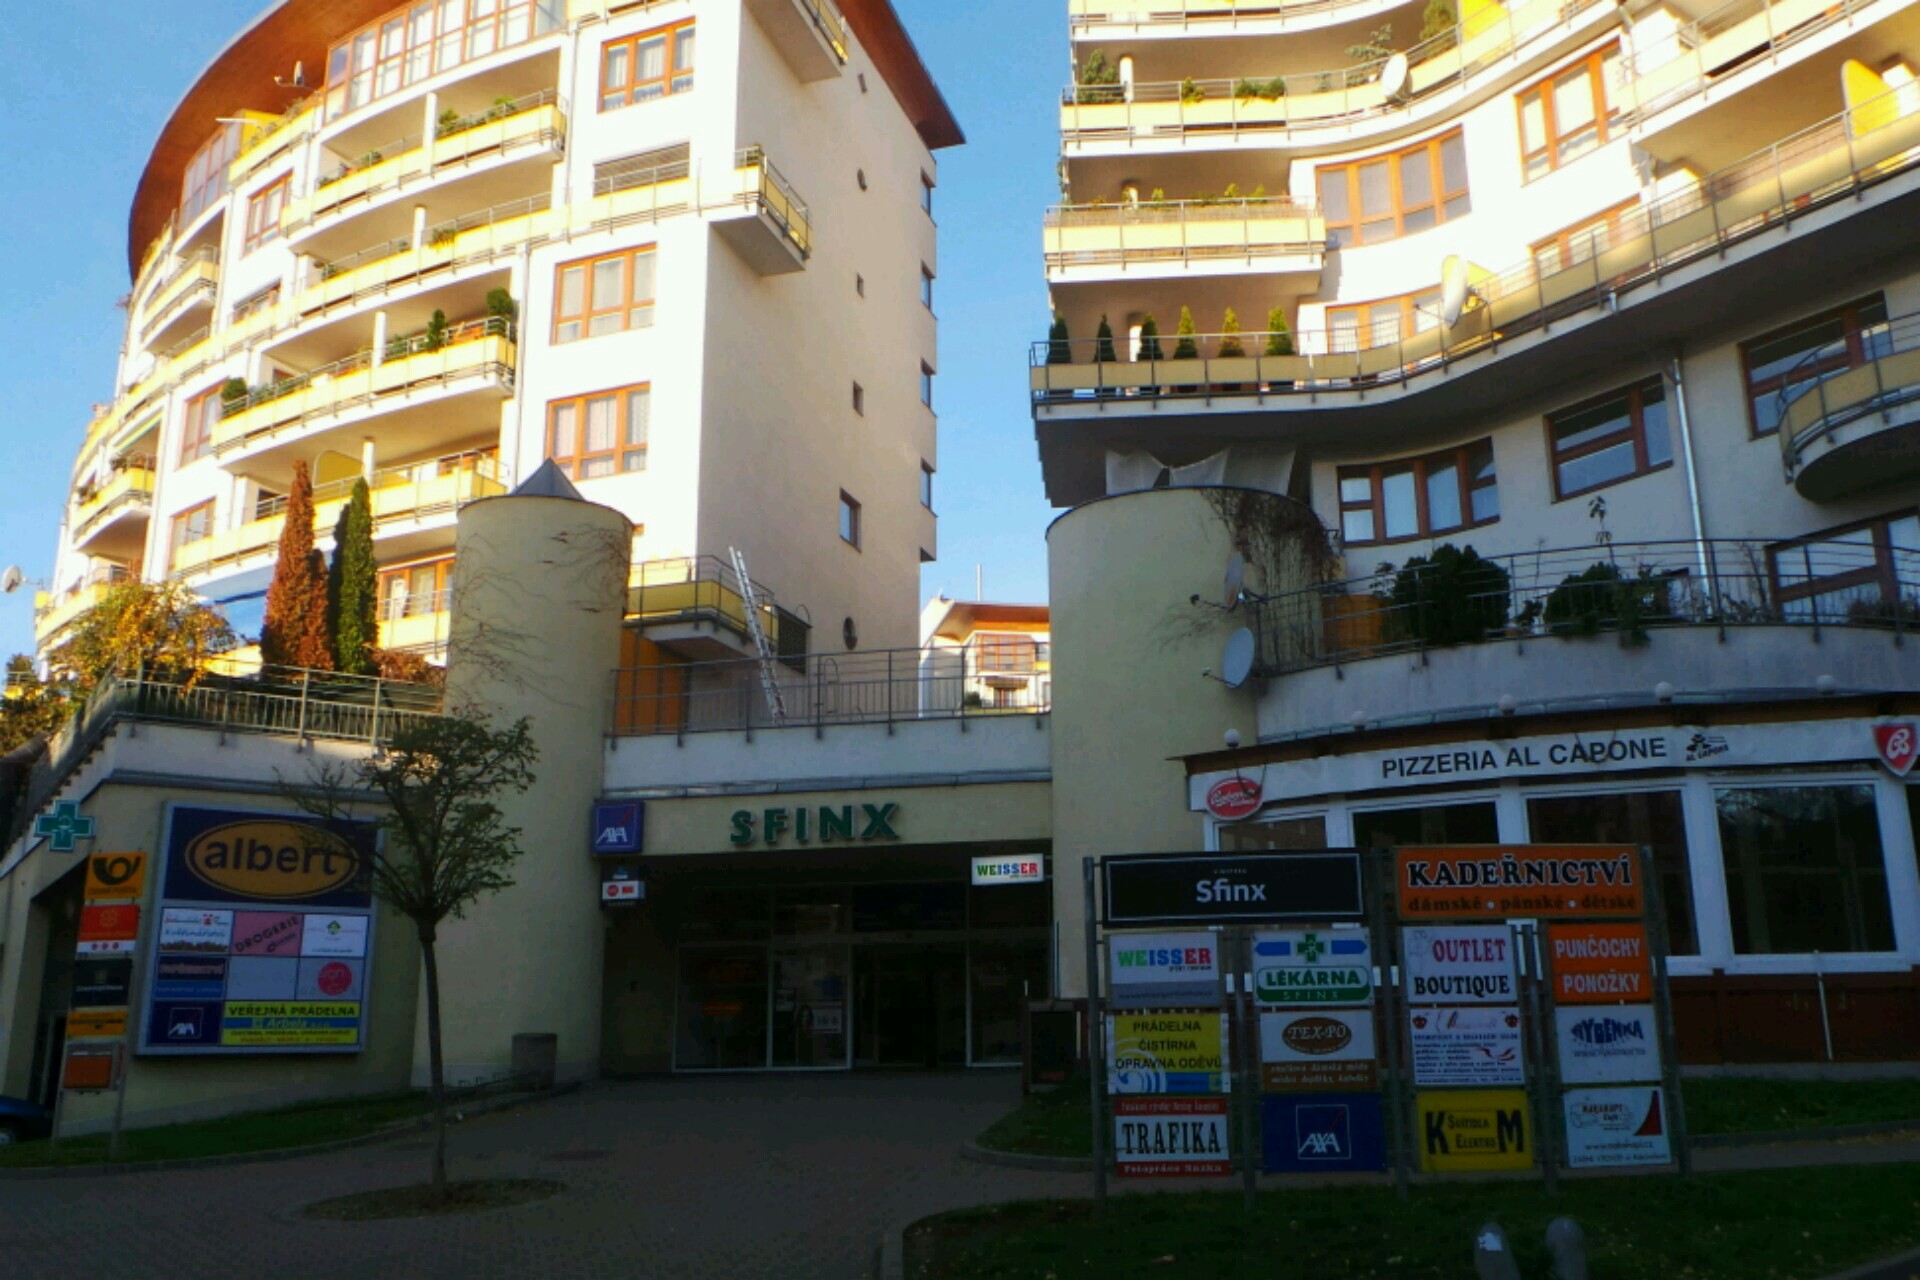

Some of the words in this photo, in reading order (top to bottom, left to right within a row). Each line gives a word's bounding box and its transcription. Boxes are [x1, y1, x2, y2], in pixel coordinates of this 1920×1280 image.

[1382, 750, 1498, 779] PIZZERIA
[1506, 747, 1540, 767] AL
[1549, 736, 1667, 765] CAPONE
[596, 827, 628, 845] AXA
[731, 804, 898, 845] SFINX
[204, 837, 337, 875] albert
[976, 862, 1038, 877] WEISSER
[1406, 854, 1633, 888] KADEŘNICTVÍ
[1196, 877, 1266, 903] Sfinx
[1407, 898, 1482, 912] dámské
[1500, 896, 1565, 912] pánské
[1581, 894, 1637, 910] dětské
[235, 915, 298, 953] DROGERIE
[1117, 947, 1213, 968] WEISSER
[1432, 938, 1507, 963] OUTLET
[1554, 935, 1641, 959] PUNČOCHY
[1265, 968, 1362, 988] LÉKÁRNA
[1413, 975, 1511, 998] BOUTIQUE
[1563, 969, 1642, 994] PONOŽKY
[1282, 990, 1340, 1001] SFINX
[228, 1003, 286, 1016] VEŘEJNÁ
[290, 1004, 356, 1016] PRÁDELNA
[1132, 1020, 1203, 1033] PRÁDELNA
[1289, 1025, 1347, 1040] TEX-PO
[1571, 1017, 1645, 1044] RYBENKA
[1138, 1038, 1197, 1052] ČISTÍRNA
[1115, 1057, 1176, 1070] OPRAVNA
[1179, 1054, 1222, 1070] ODĚVŮ
[1121, 1121, 1222, 1155] TRAFIKA
[1298, 1131, 1341, 1154] AXA
[1426, 1111, 1451, 1155] K
[1496, 1109, 1525, 1153] M
